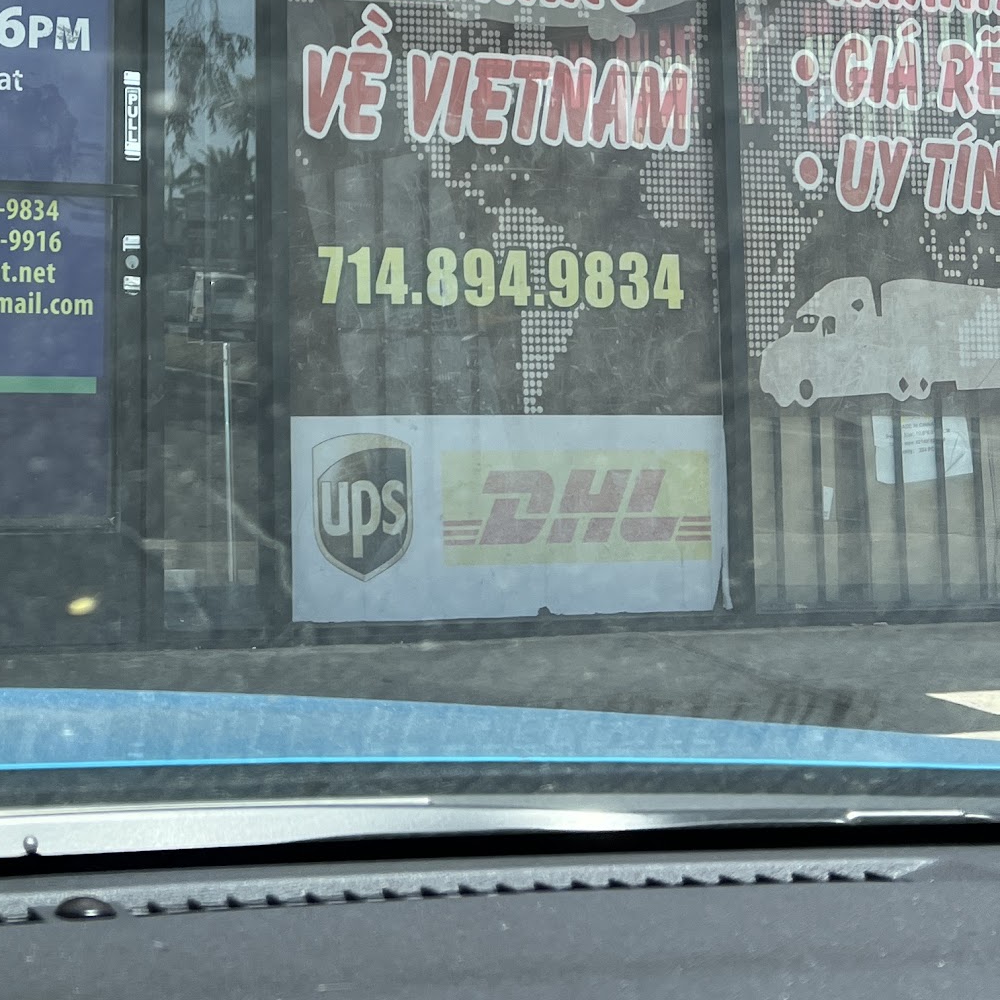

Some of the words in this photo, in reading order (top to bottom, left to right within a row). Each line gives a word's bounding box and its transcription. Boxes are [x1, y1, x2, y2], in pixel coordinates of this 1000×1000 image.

[303, 3, 392, 140] VỀ
[408, 50, 695, 151] VIETNAM
[831, 18, 922, 110] GIÁ
[127, 93, 138, 142] PULL
[836, 133, 912, 213] UY
[317, 246, 684, 310] 714.894.9834
[479, 469, 680, 545] DHL
